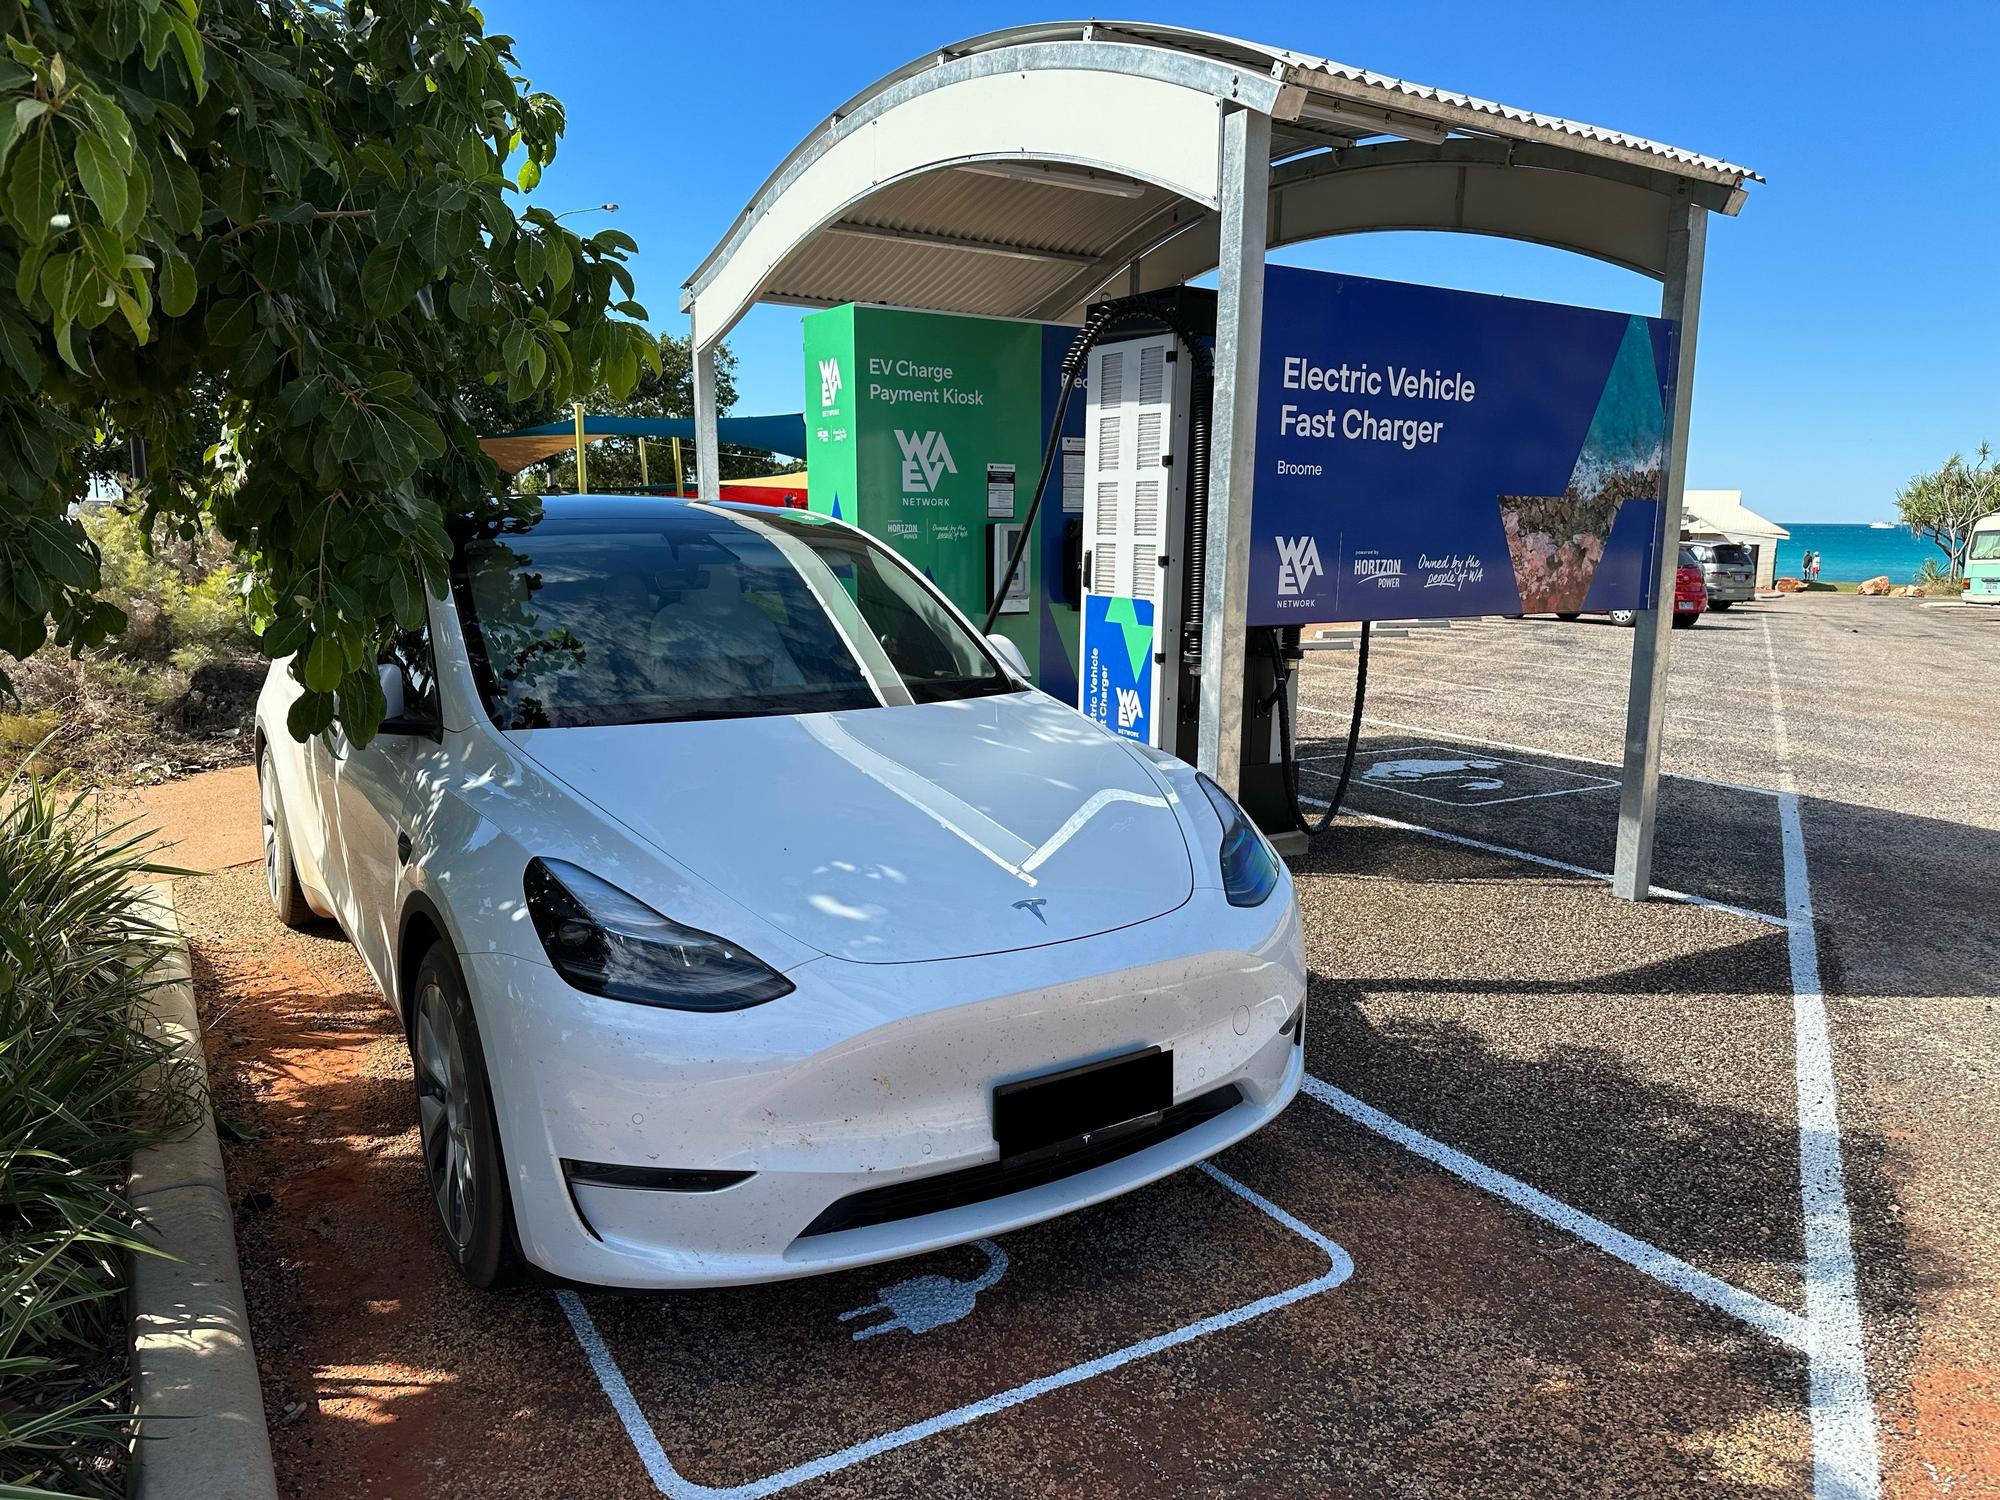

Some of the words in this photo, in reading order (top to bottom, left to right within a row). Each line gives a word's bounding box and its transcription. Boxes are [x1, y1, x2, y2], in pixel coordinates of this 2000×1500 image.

[869, 358, 893, 375] EV
[895, 360, 953, 382] Charge
[1283, 356, 1382, 395] Electric
[1387, 366, 1476, 402] Vehicle
[870, 383, 939, 405] Payment
[943, 388, 984, 406] Kiosk
[1280, 404, 1336, 438] Fast
[1342, 408, 1444, 450] Charger
[1277, 460, 1323, 476] Broome
[902, 497, 950, 507] NETWORK
[887, 523, 918, 533] HORIZON
[1354, 559, 1402, 575] HORIZON
[1418, 553, 1449, 569] Owned
[1451, 554, 1464, 575] by
[1465, 554, 1480, 568] the
[1377, 577, 1400, 588] POWER
[1426, 570, 1456, 587] people
[1457, 569, 1468, 592] of
[1469, 567, 1483, 583] WA
[1276, 599, 1315, 608] NETWORK
[1090, 647, 1100, 694] Vehicle
[1100, 665, 1110, 717] Charger
